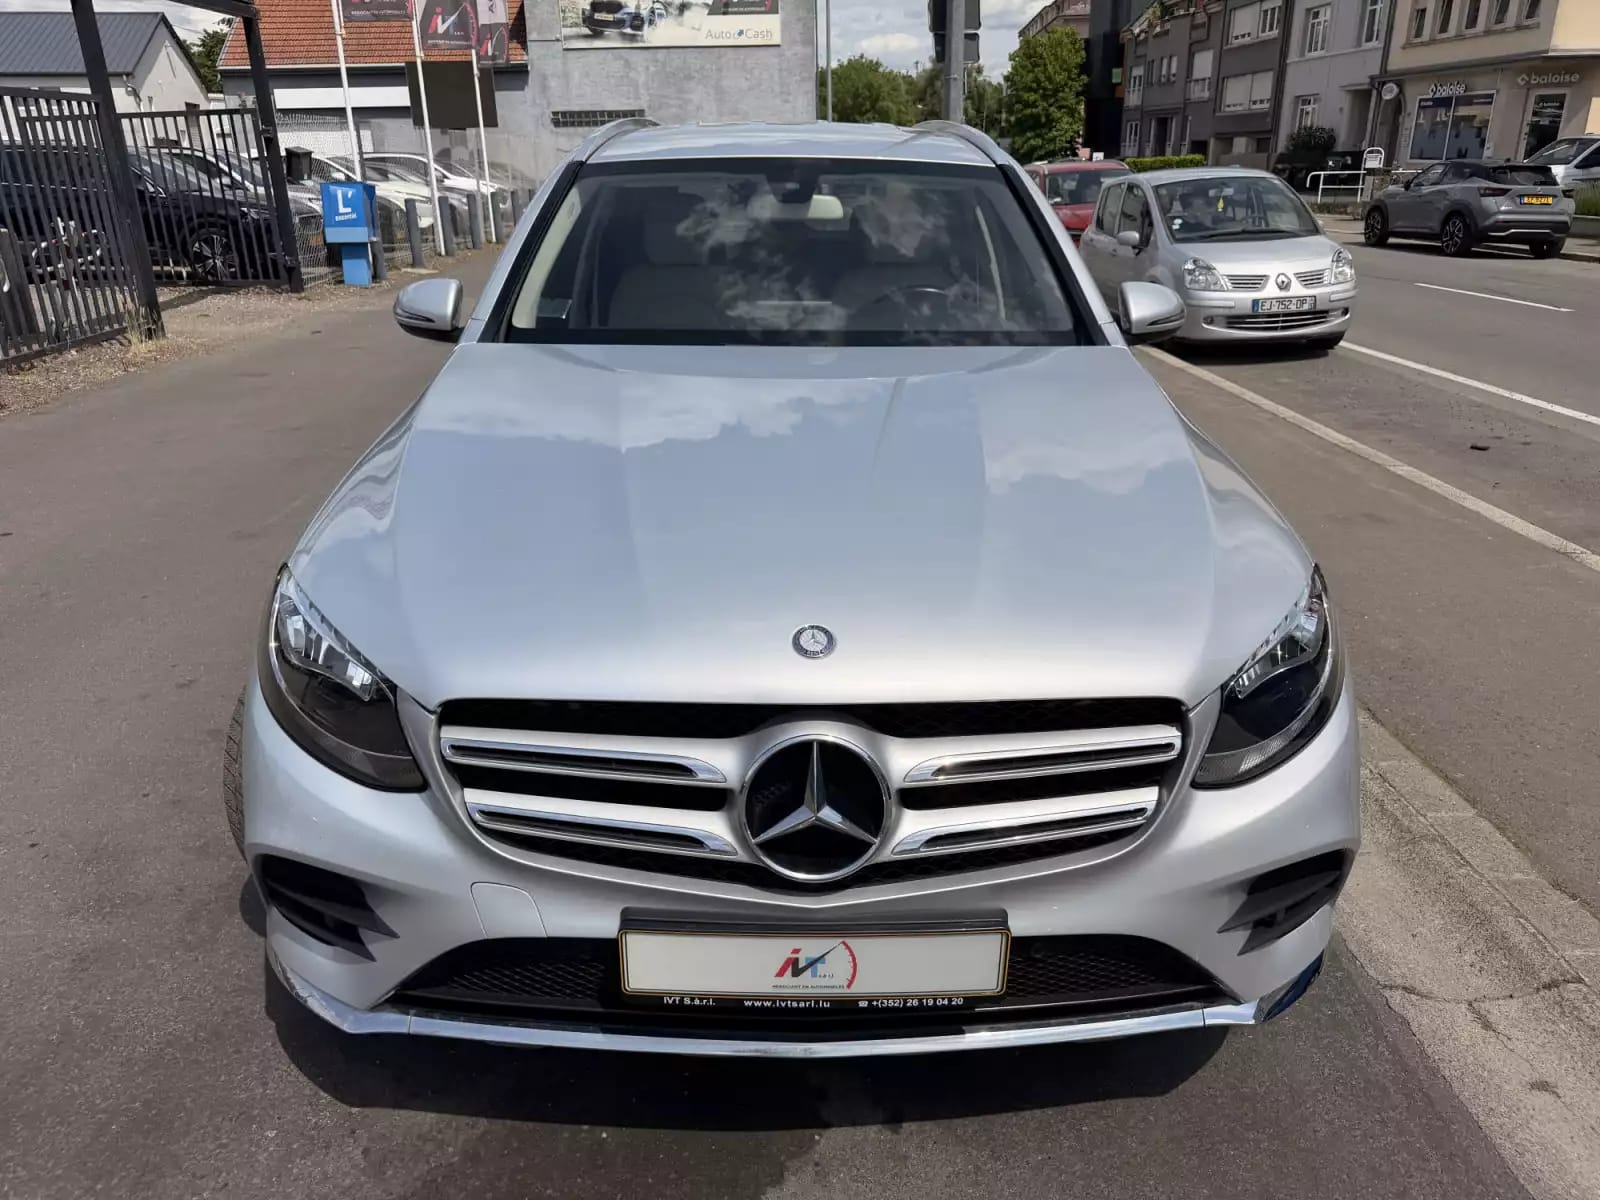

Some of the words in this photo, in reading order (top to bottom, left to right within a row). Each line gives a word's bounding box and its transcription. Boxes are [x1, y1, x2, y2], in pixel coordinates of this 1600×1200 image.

[745, 28, 773, 40] Cash
[1531, 71, 1580, 85] baloise
[1436, 81, 1467, 95] baloise
[663, 996, 681, 1005] IVT
[743, 999, 831, 1008] www.ivtsarl.lu
[871, 999, 904, 1008] +(352)
[906, 999, 919, 1007] 26
[922, 998, 934, 1006] 19
[951, 997, 964, 1005] 20
